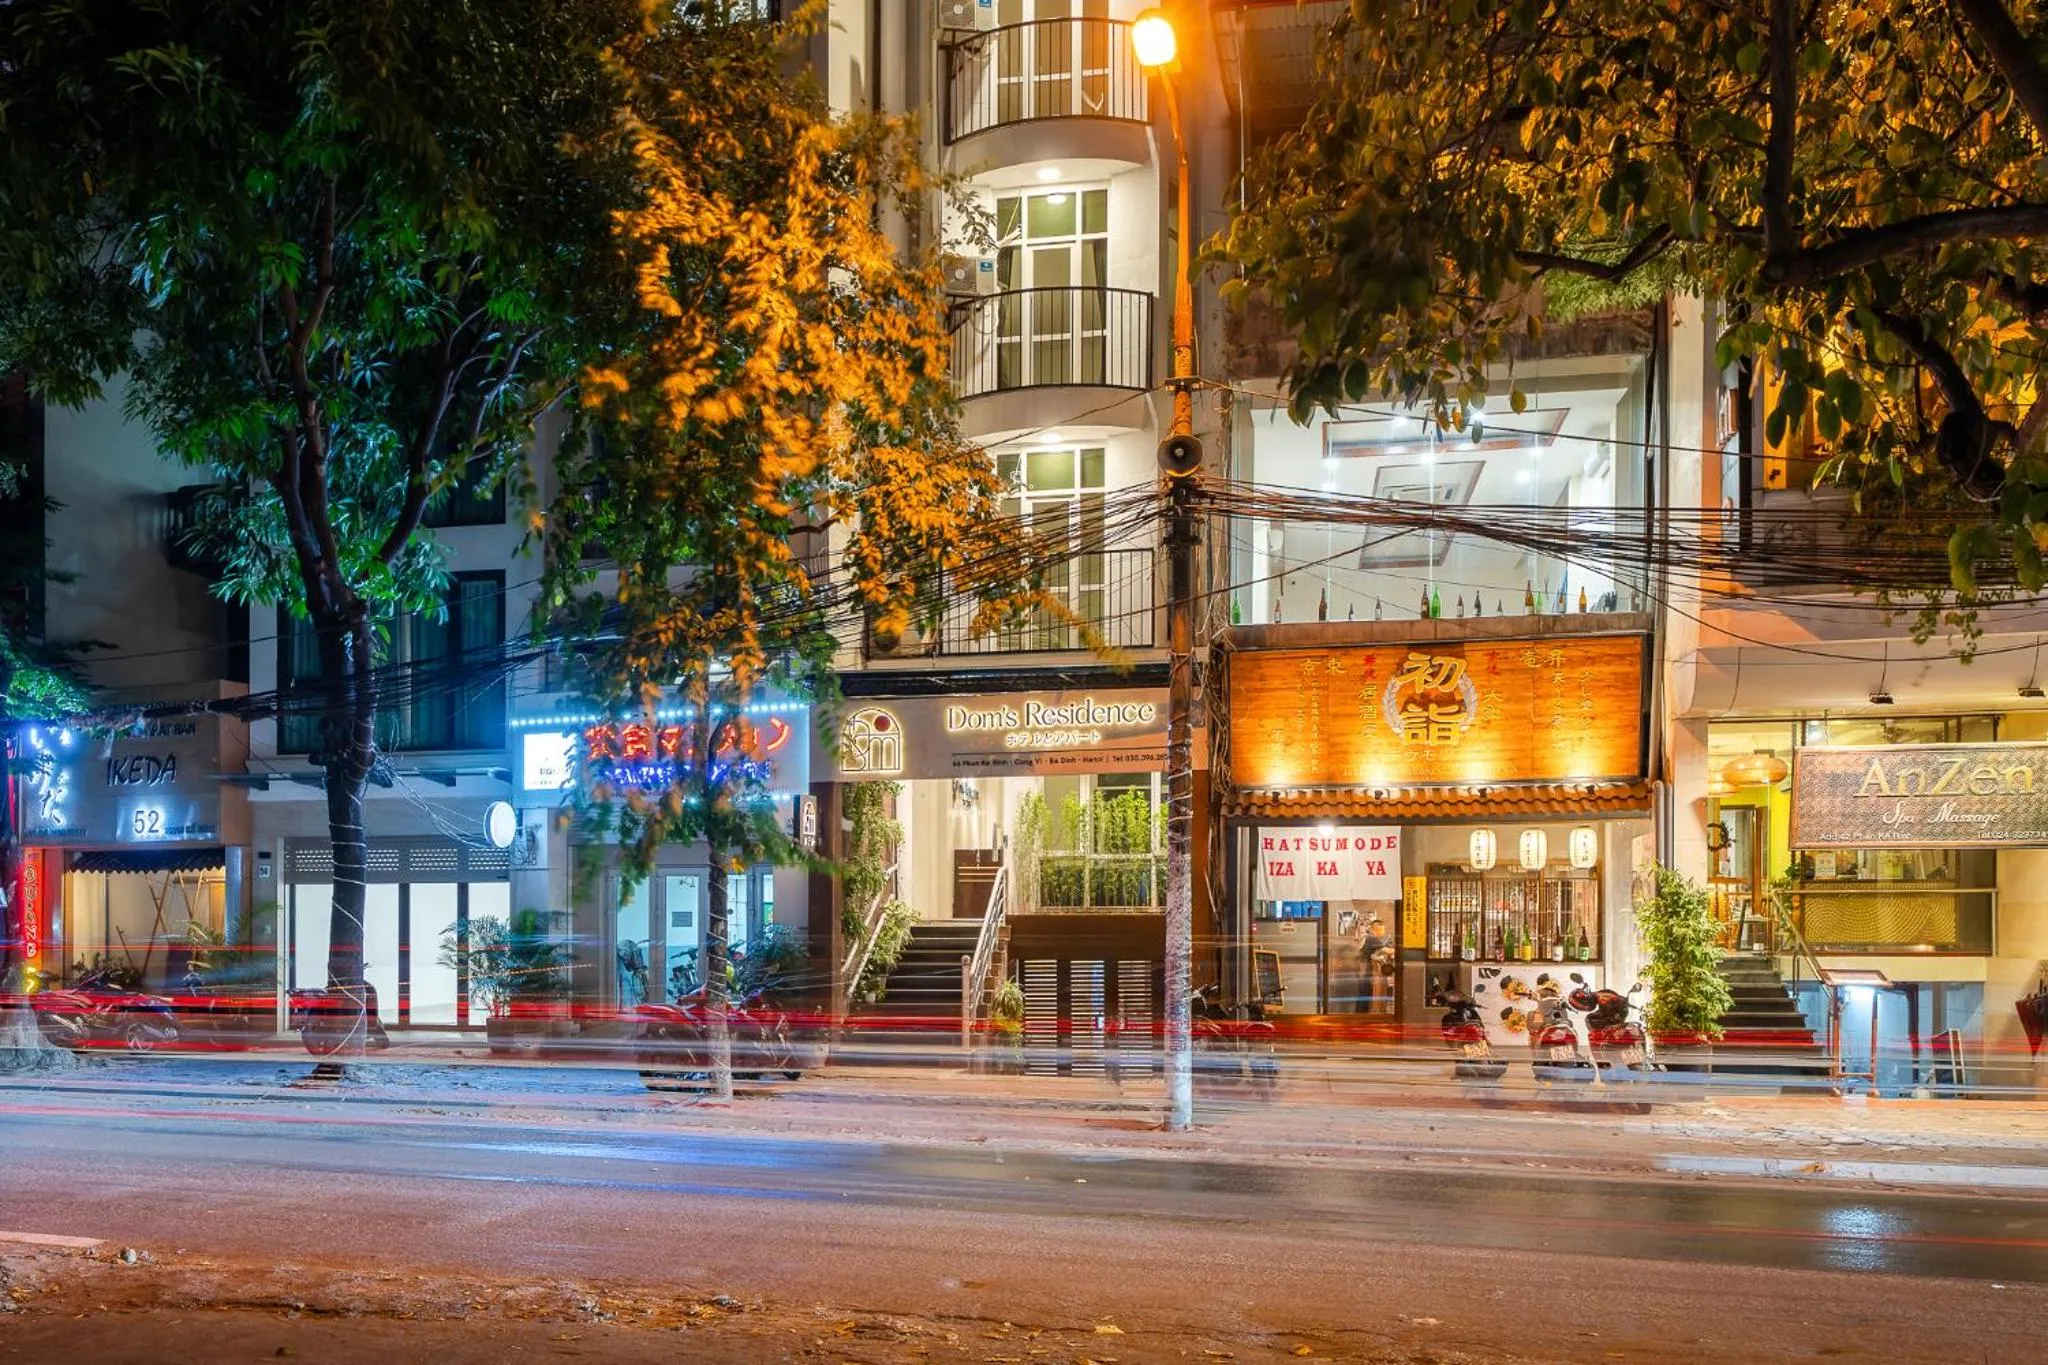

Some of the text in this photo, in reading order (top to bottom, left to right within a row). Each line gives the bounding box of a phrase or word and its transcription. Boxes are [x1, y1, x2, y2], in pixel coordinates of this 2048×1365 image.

[1395, 652, 1467, 746] 初詣
[947, 699, 1154, 731] Dom's Residence
[106, 753, 178, 787] IKEDA
[1853, 755, 2036, 798] AnZen
[134, 810, 160, 834] 52
[1882, 800, 2002, 829] Spa Massage
[1262, 836, 1398, 851] HATSUMODE
[1269, 861, 1387, 876] IZA KA YA
